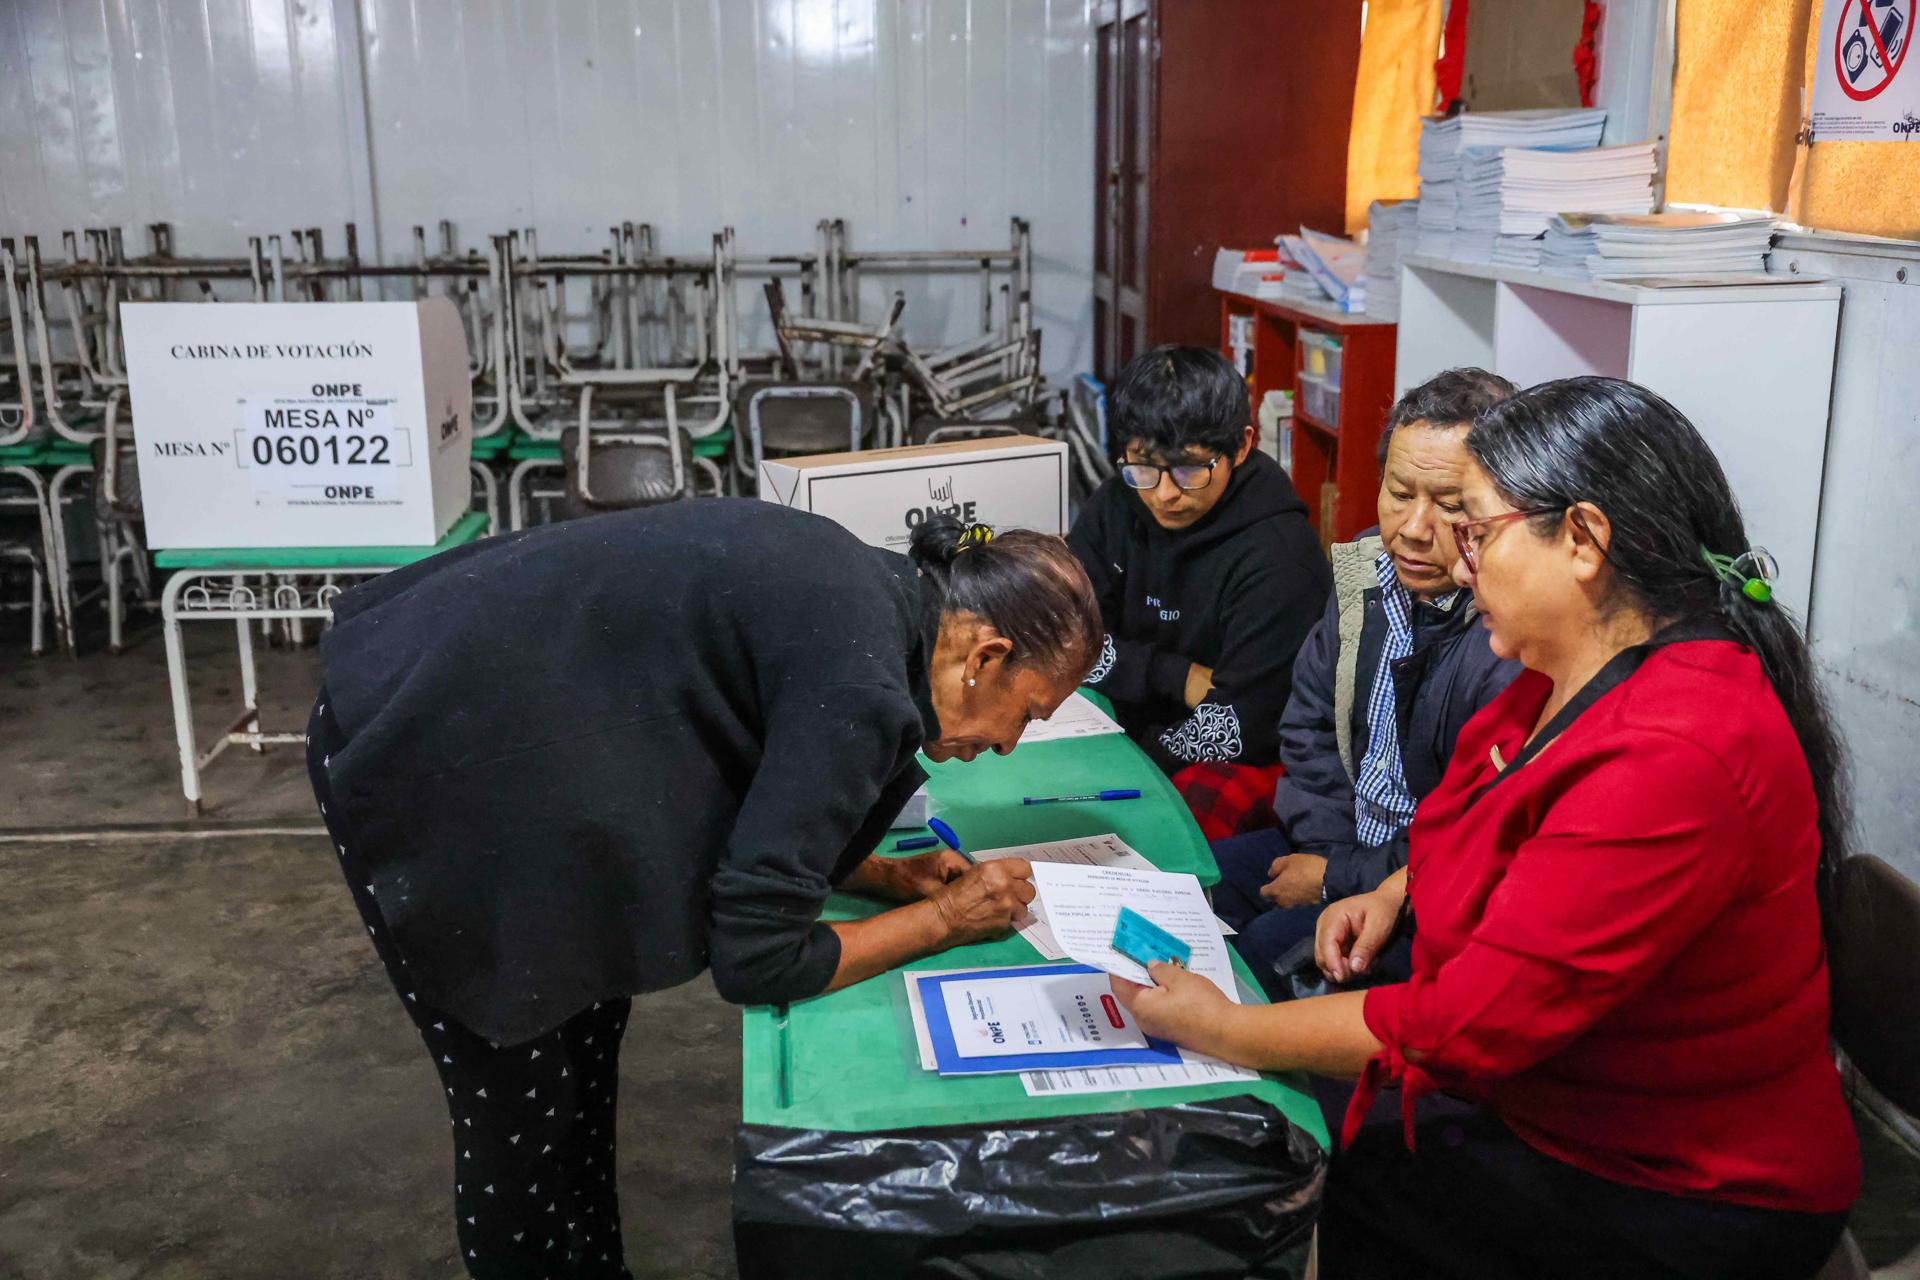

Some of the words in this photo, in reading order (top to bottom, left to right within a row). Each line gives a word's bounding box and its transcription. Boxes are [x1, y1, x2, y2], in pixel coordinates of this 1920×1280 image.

[1892, 121, 1920, 134] ONPE
[170, 344, 242, 359] CABINA
[246, 344, 271, 359] DE
[275, 340, 374, 359] VOTACIÓN
[312, 383, 362, 397] ONPE
[264, 408, 340, 428] MESA
[153, 441, 208, 457] MESA
[252, 435, 391, 466] 060122
[324, 485, 375, 499] ONPE
[1160, 609, 1180, 621] GIO
[987, 1021, 1006, 1044] ONPE
